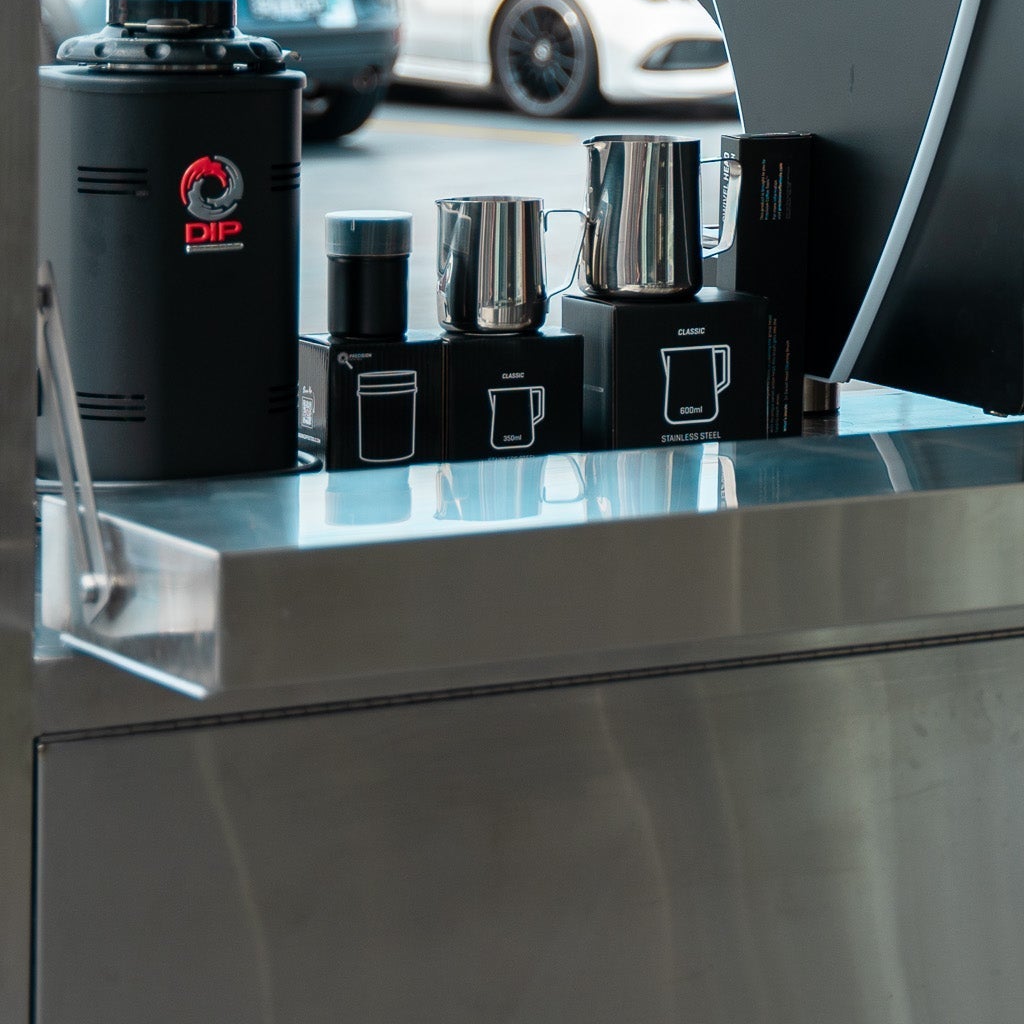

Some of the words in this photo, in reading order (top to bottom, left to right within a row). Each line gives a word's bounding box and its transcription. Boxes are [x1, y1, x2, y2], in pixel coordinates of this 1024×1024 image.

[185, 220, 243, 244] DIP
[678, 327, 705, 336] CLASSIC
[680, 406, 703, 415] 600ml
[503, 434, 522, 442] 350ml
[661, 432, 699, 443] STAINLESS
[700, 431, 721, 440] STEEL
